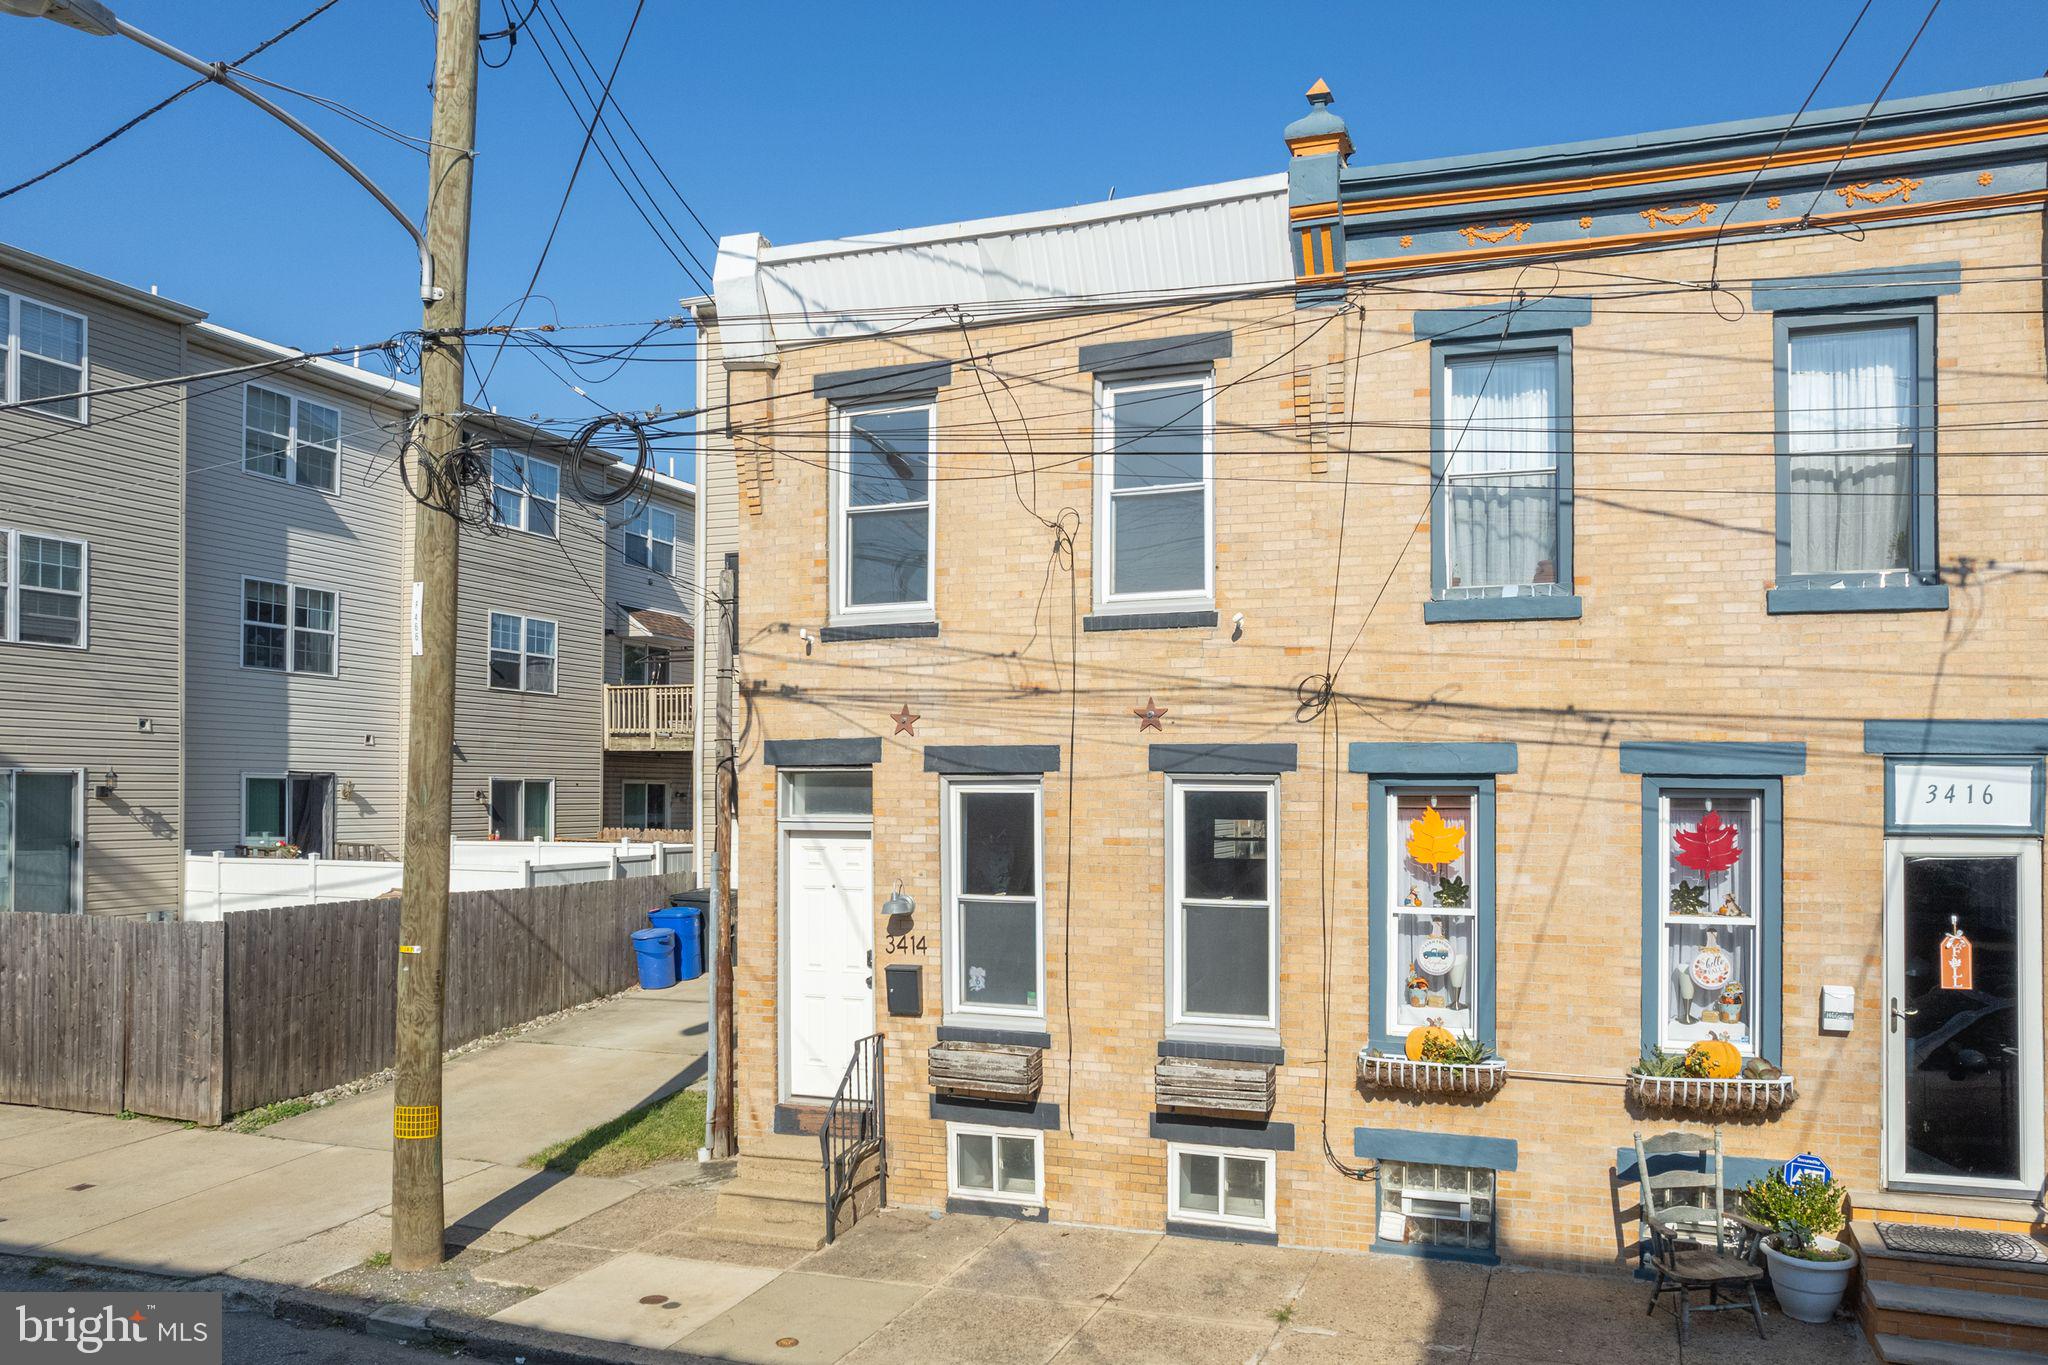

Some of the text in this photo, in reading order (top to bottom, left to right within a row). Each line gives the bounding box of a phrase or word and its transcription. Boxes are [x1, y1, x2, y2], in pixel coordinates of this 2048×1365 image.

[1925, 784, 1993, 804] 3416
[885, 935, 928, 956] 3414
[1948, 946, 1963, 988] FLL
